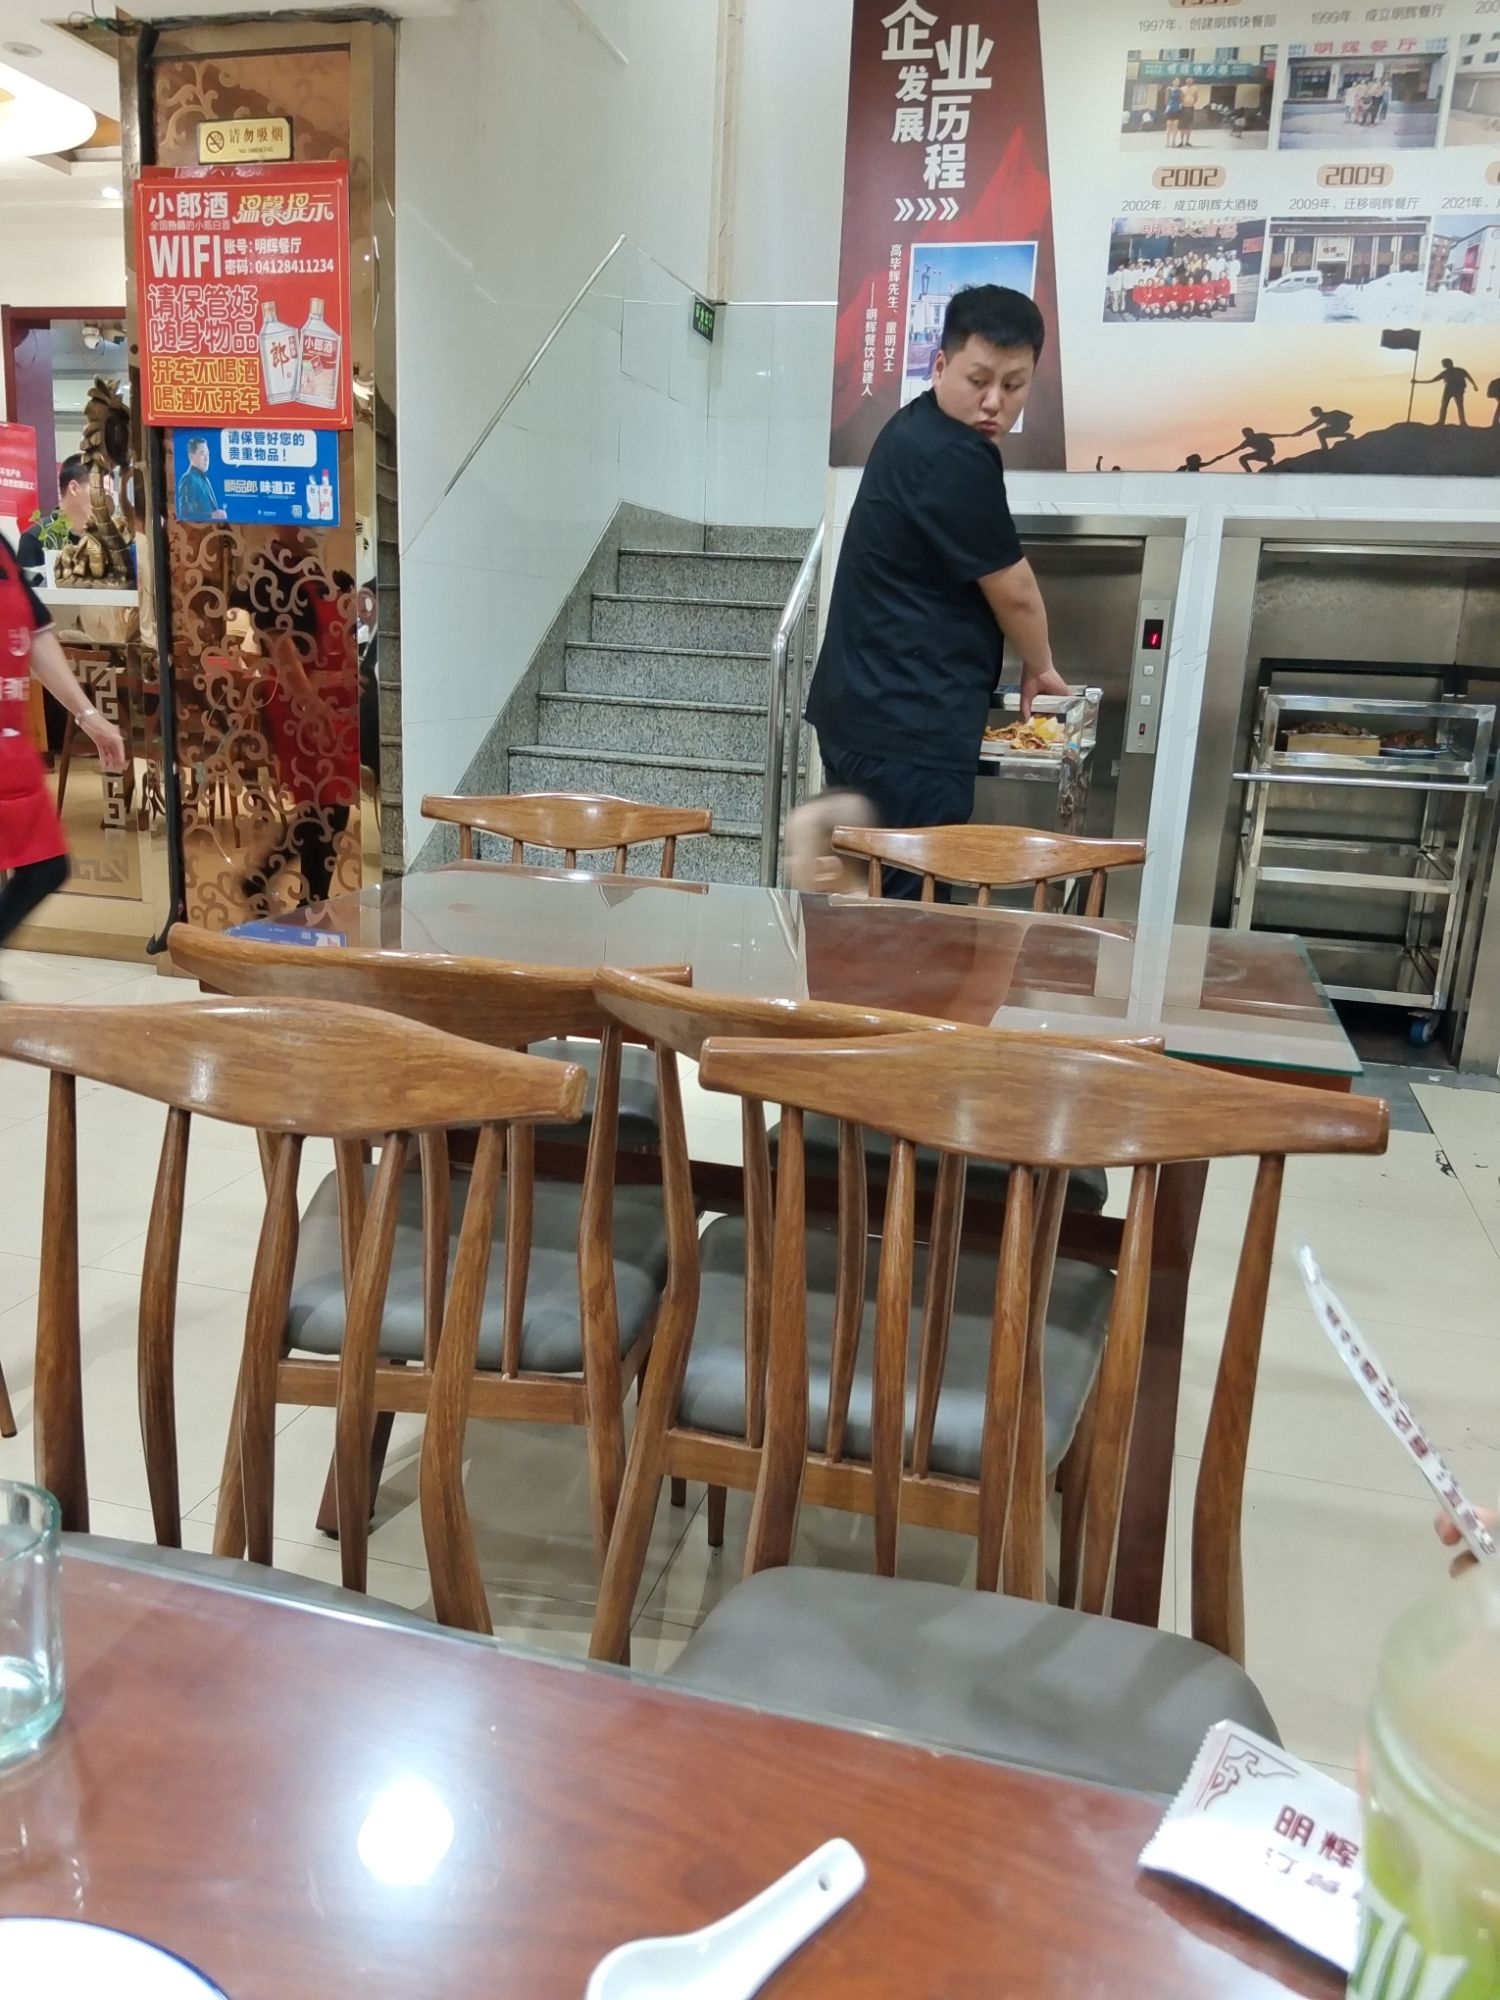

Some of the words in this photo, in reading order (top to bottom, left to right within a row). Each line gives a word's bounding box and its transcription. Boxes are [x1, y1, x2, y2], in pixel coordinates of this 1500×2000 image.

[891, 65, 929, 143] 发展
[229, 127, 283, 144] 请勿吸烟
[923, 95, 973, 190] 历程
[1161, 168, 1218, 187] 2002
[1325, 166, 1385, 186] 2009
[149, 191, 228, 219] 小郎酒
[232, 193, 334, 226] 温馨提示
[1441, 197, 1500, 209] 2021年，
[149, 235, 222, 278] WIFI
[149, 284, 258, 319] 请保管好
[150, 318, 259, 354] 随身物品
[152, 356, 260, 385] 开车不喝酒
[154, 384, 260, 413] 喝酒不开车
[228, 431, 305, 447] 请保管好您的
[1273, 1804, 1360, 1869] 明辉
